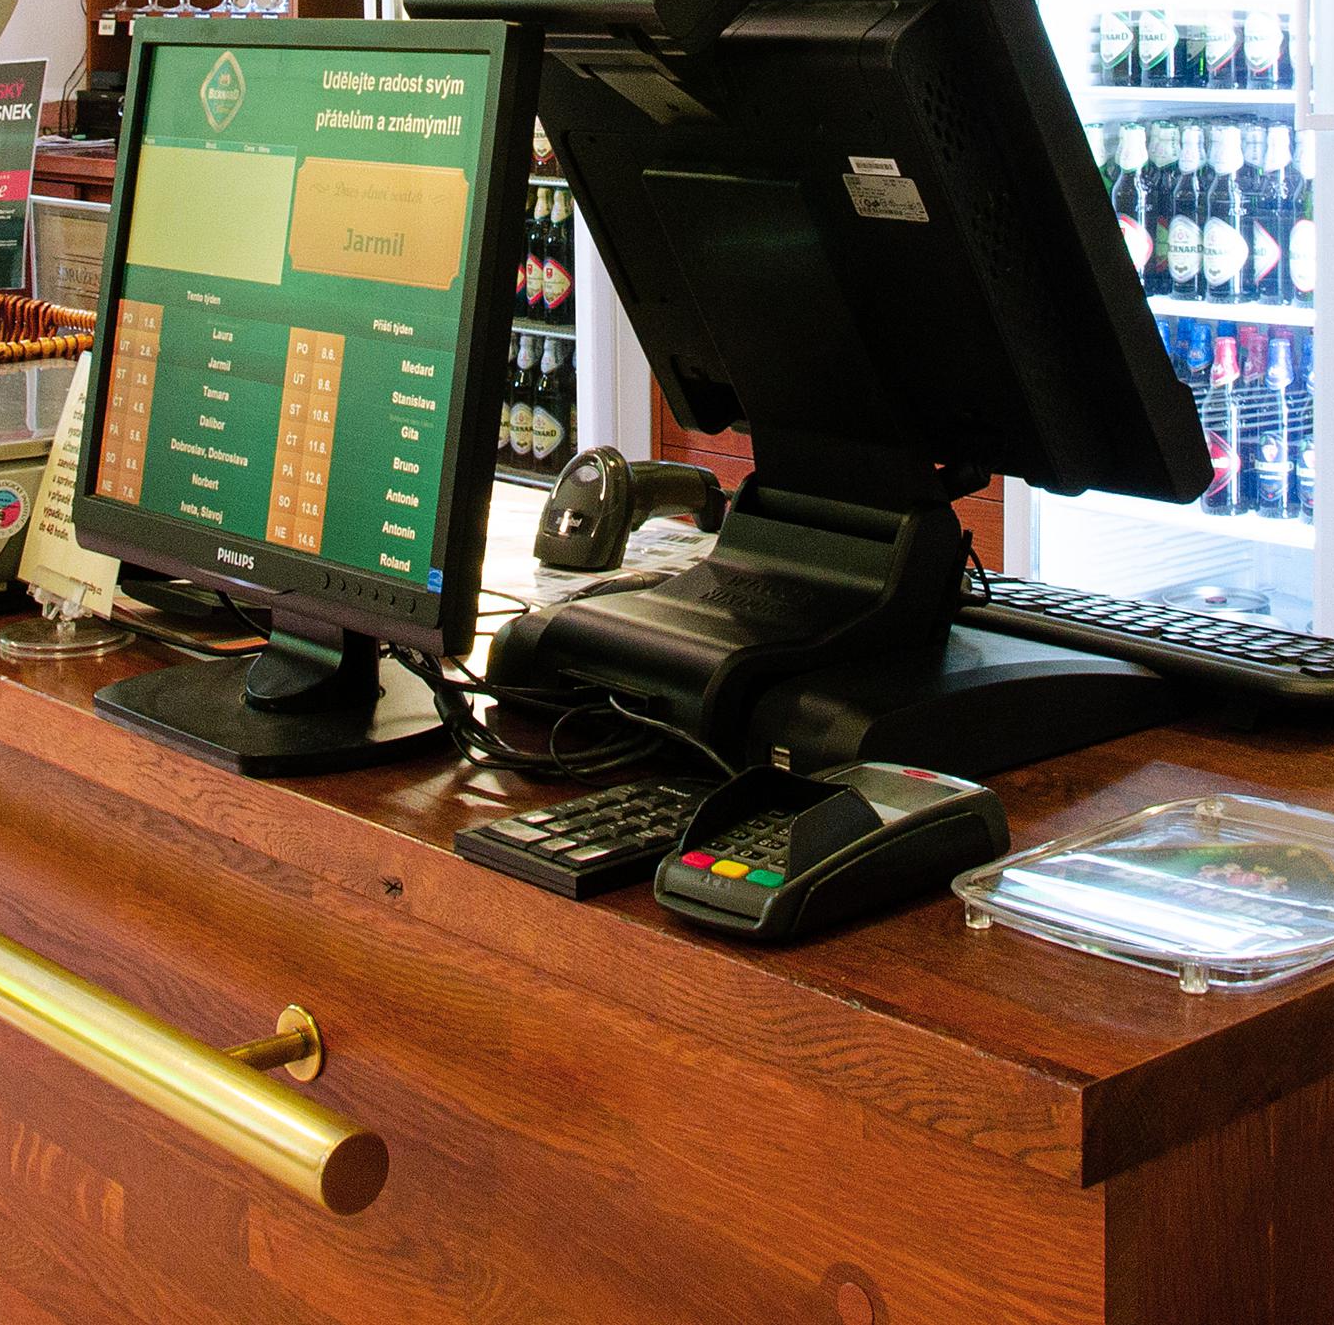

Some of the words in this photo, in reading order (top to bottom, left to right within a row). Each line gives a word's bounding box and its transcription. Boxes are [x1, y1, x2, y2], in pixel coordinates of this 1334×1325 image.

[322, 70, 376, 95] Udělejte
[378, 73, 424, 94] radost
[425, 75, 466, 100] svým
[315, 108, 375, 133] přátelům
[376, 118, 386, 132] a
[387, 113, 463, 140] známým!!!
[342, 227, 406, 257] Jarmil
[186, 290, 203, 304] Tento
[203, 293, 221, 306] týden
[123, 313, 134, 325] PO
[372, 318, 393, 334] Příští
[393, 321, 414, 337] týden
[212, 327, 234, 343] Laura
[296, 342, 309, 356] PO
[320, 347, 336, 361] 8.6.
[116, 368, 127, 380] ST
[207, 357, 232, 372] Jarmil
[401, 360, 435, 378] Medard
[202, 385, 230, 402] Tamara
[317, 378, 333, 392] 9.6.
[391, 391, 437, 411] Stanislava
[199, 414, 226, 431] Dalibor
[289, 403, 303, 416] ST
[312, 409, 332, 424] 10.6.
[286, 431, 299, 447] ČT
[308, 439, 328, 454] 11.6.
[400, 426, 420, 442] Gita
[105, 451, 117, 465] SO
[170, 437, 208, 459] Dobroslav,
[208, 446, 249, 467] Dobroslava
[282, 462, 294, 477] PÁ
[305, 470, 324, 485] 12.6.
[392, 456, 420, 474] Bruno
[191, 472, 220, 491] Norbert
[278, 494, 292, 509] SO
[301, 502, 321, 518] 13.6.
[385, 488, 420, 508] Antonie
[180, 500, 200, 518] Iveta,
[200, 505, 224, 525] Slavoj
[274, 525, 288, 540] NE
[297, 534, 317, 549] 14.6.
[216, 546, 255, 571] PHILIPS
[379, 552, 412, 572] Roland
